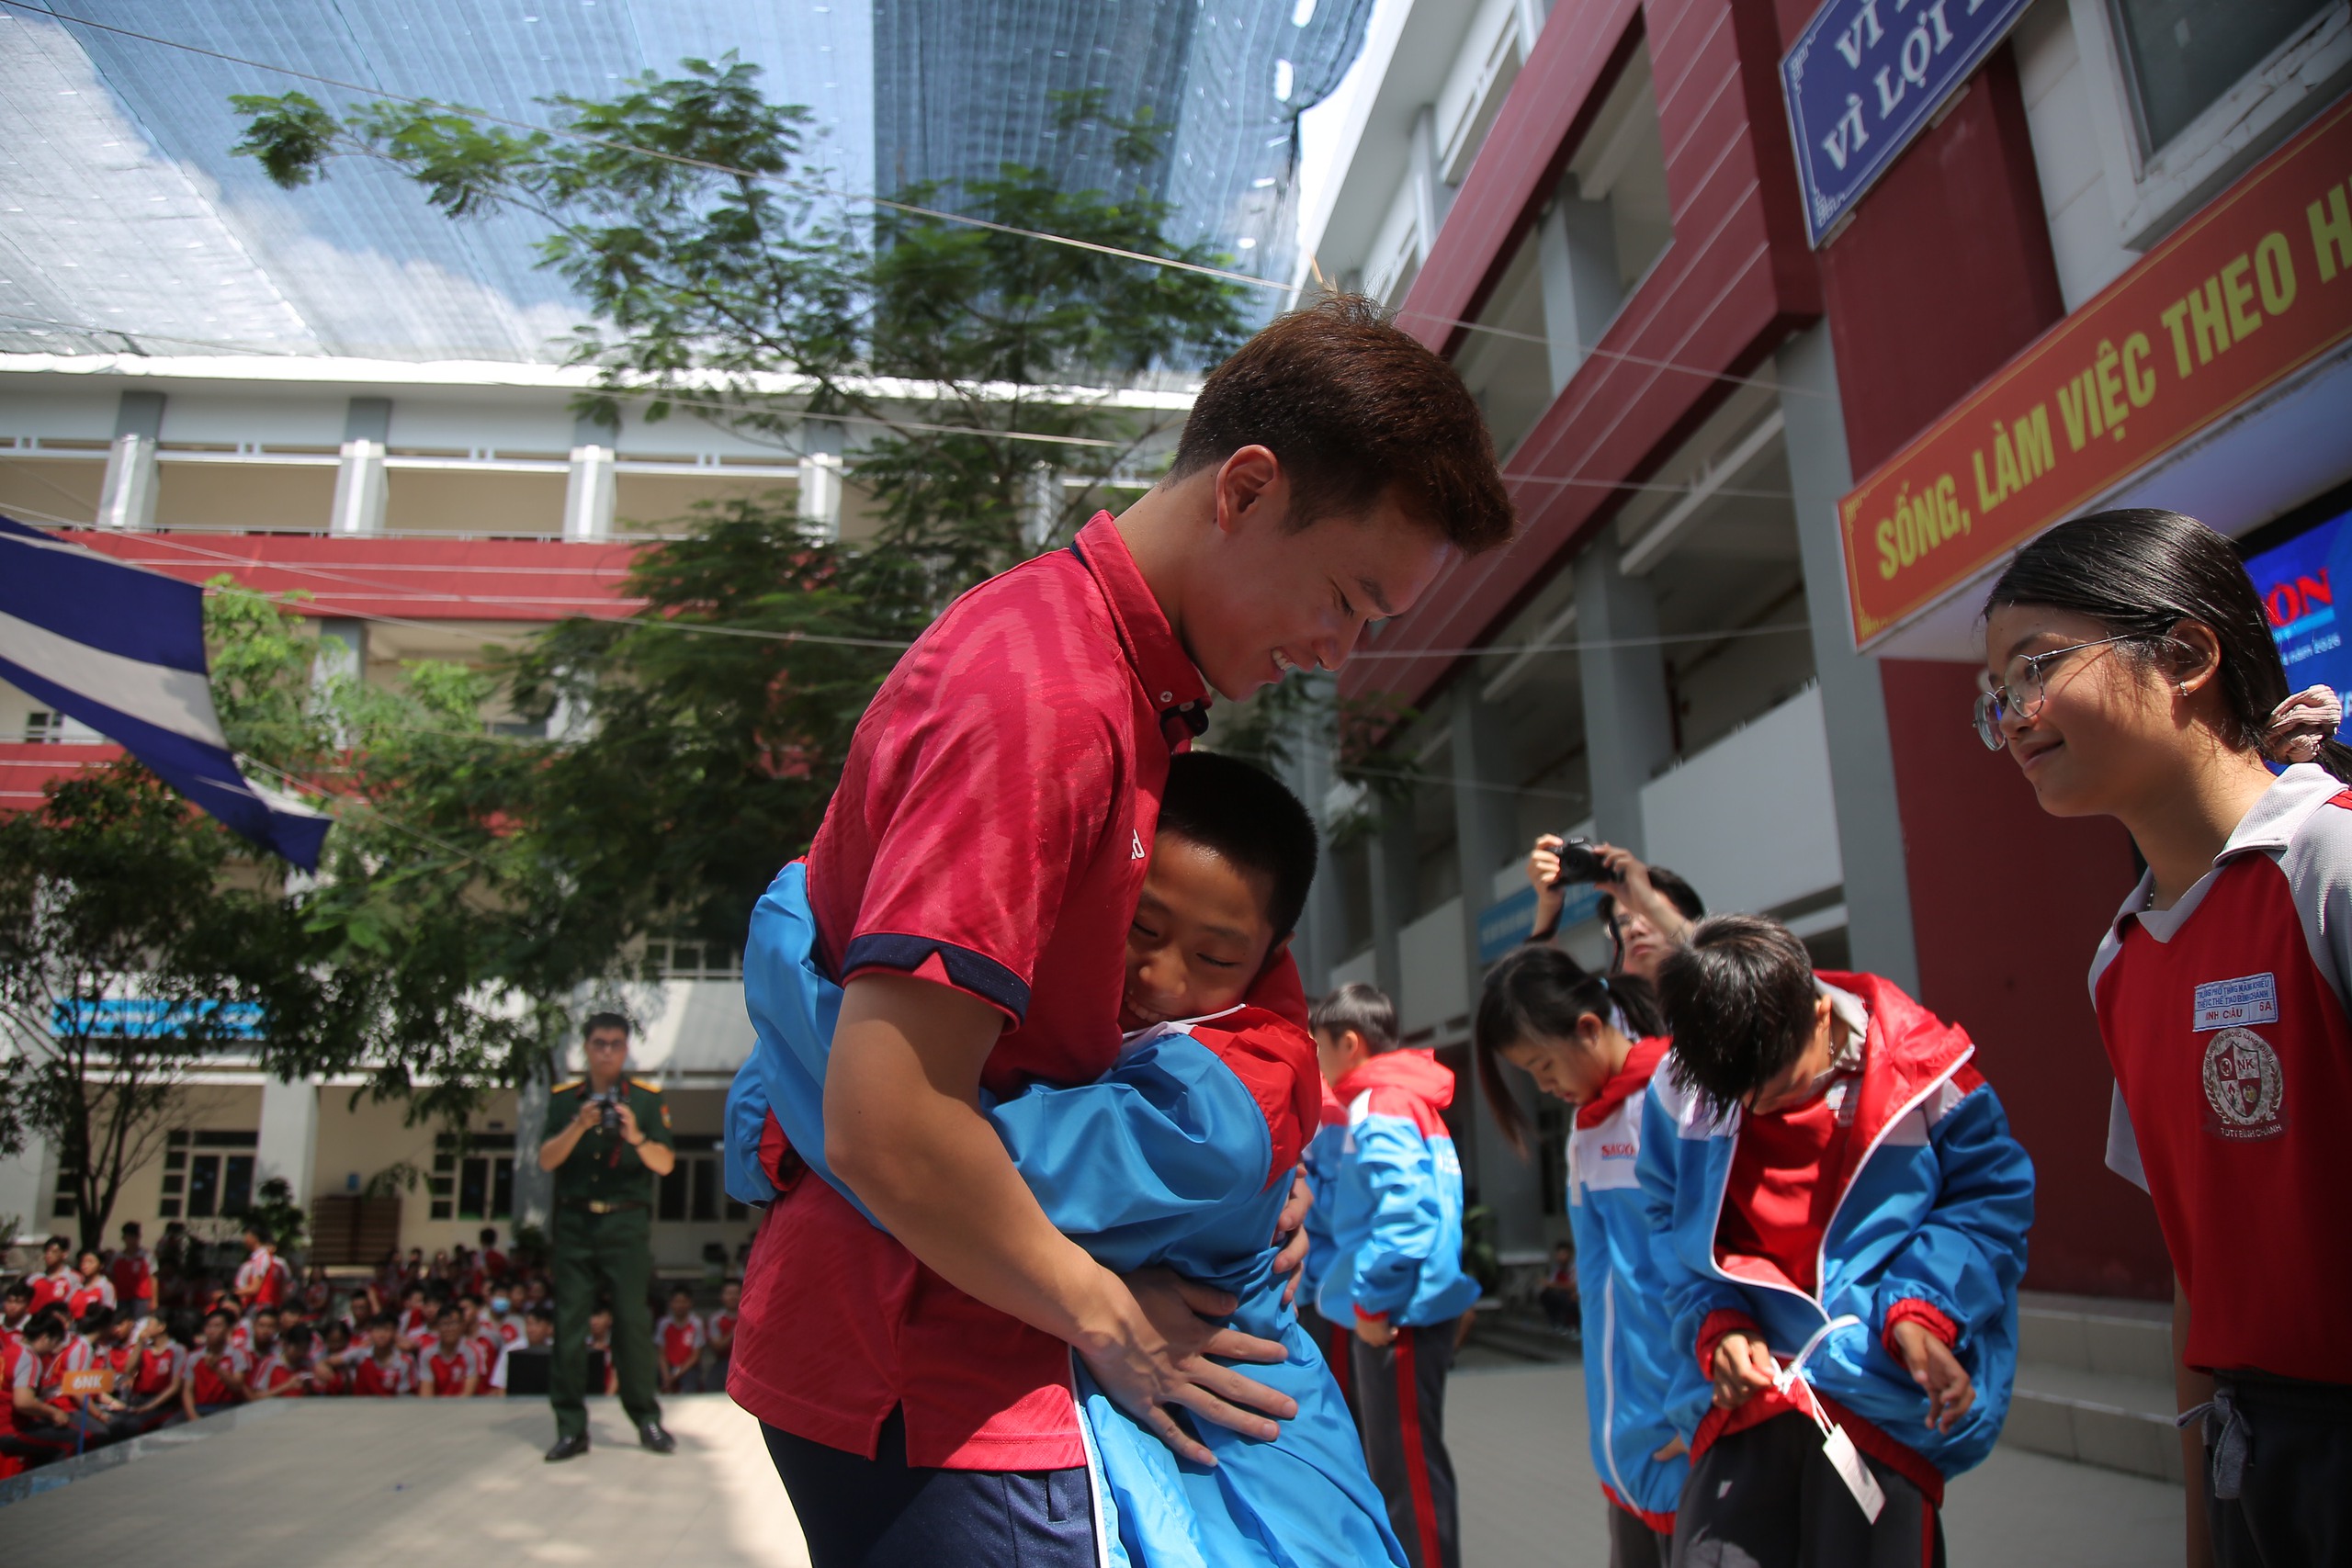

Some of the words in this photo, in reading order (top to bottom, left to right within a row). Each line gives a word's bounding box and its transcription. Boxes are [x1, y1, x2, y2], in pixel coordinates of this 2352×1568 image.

[1821, 93, 1870, 172] VÌ
[1872, 0, 1954, 120] LỢI
[1875, 479, 1972, 581] SỐNG,
[1972, 419, 2056, 514] LÀM
[2056, 331, 2156, 453] VIỆC
[2161, 231, 2298, 379] THEO
[2306, 175, 2352, 285] H
[2259, 1001, 2272, 1011] 6A
[2237, 1057, 2256, 1071] NK
